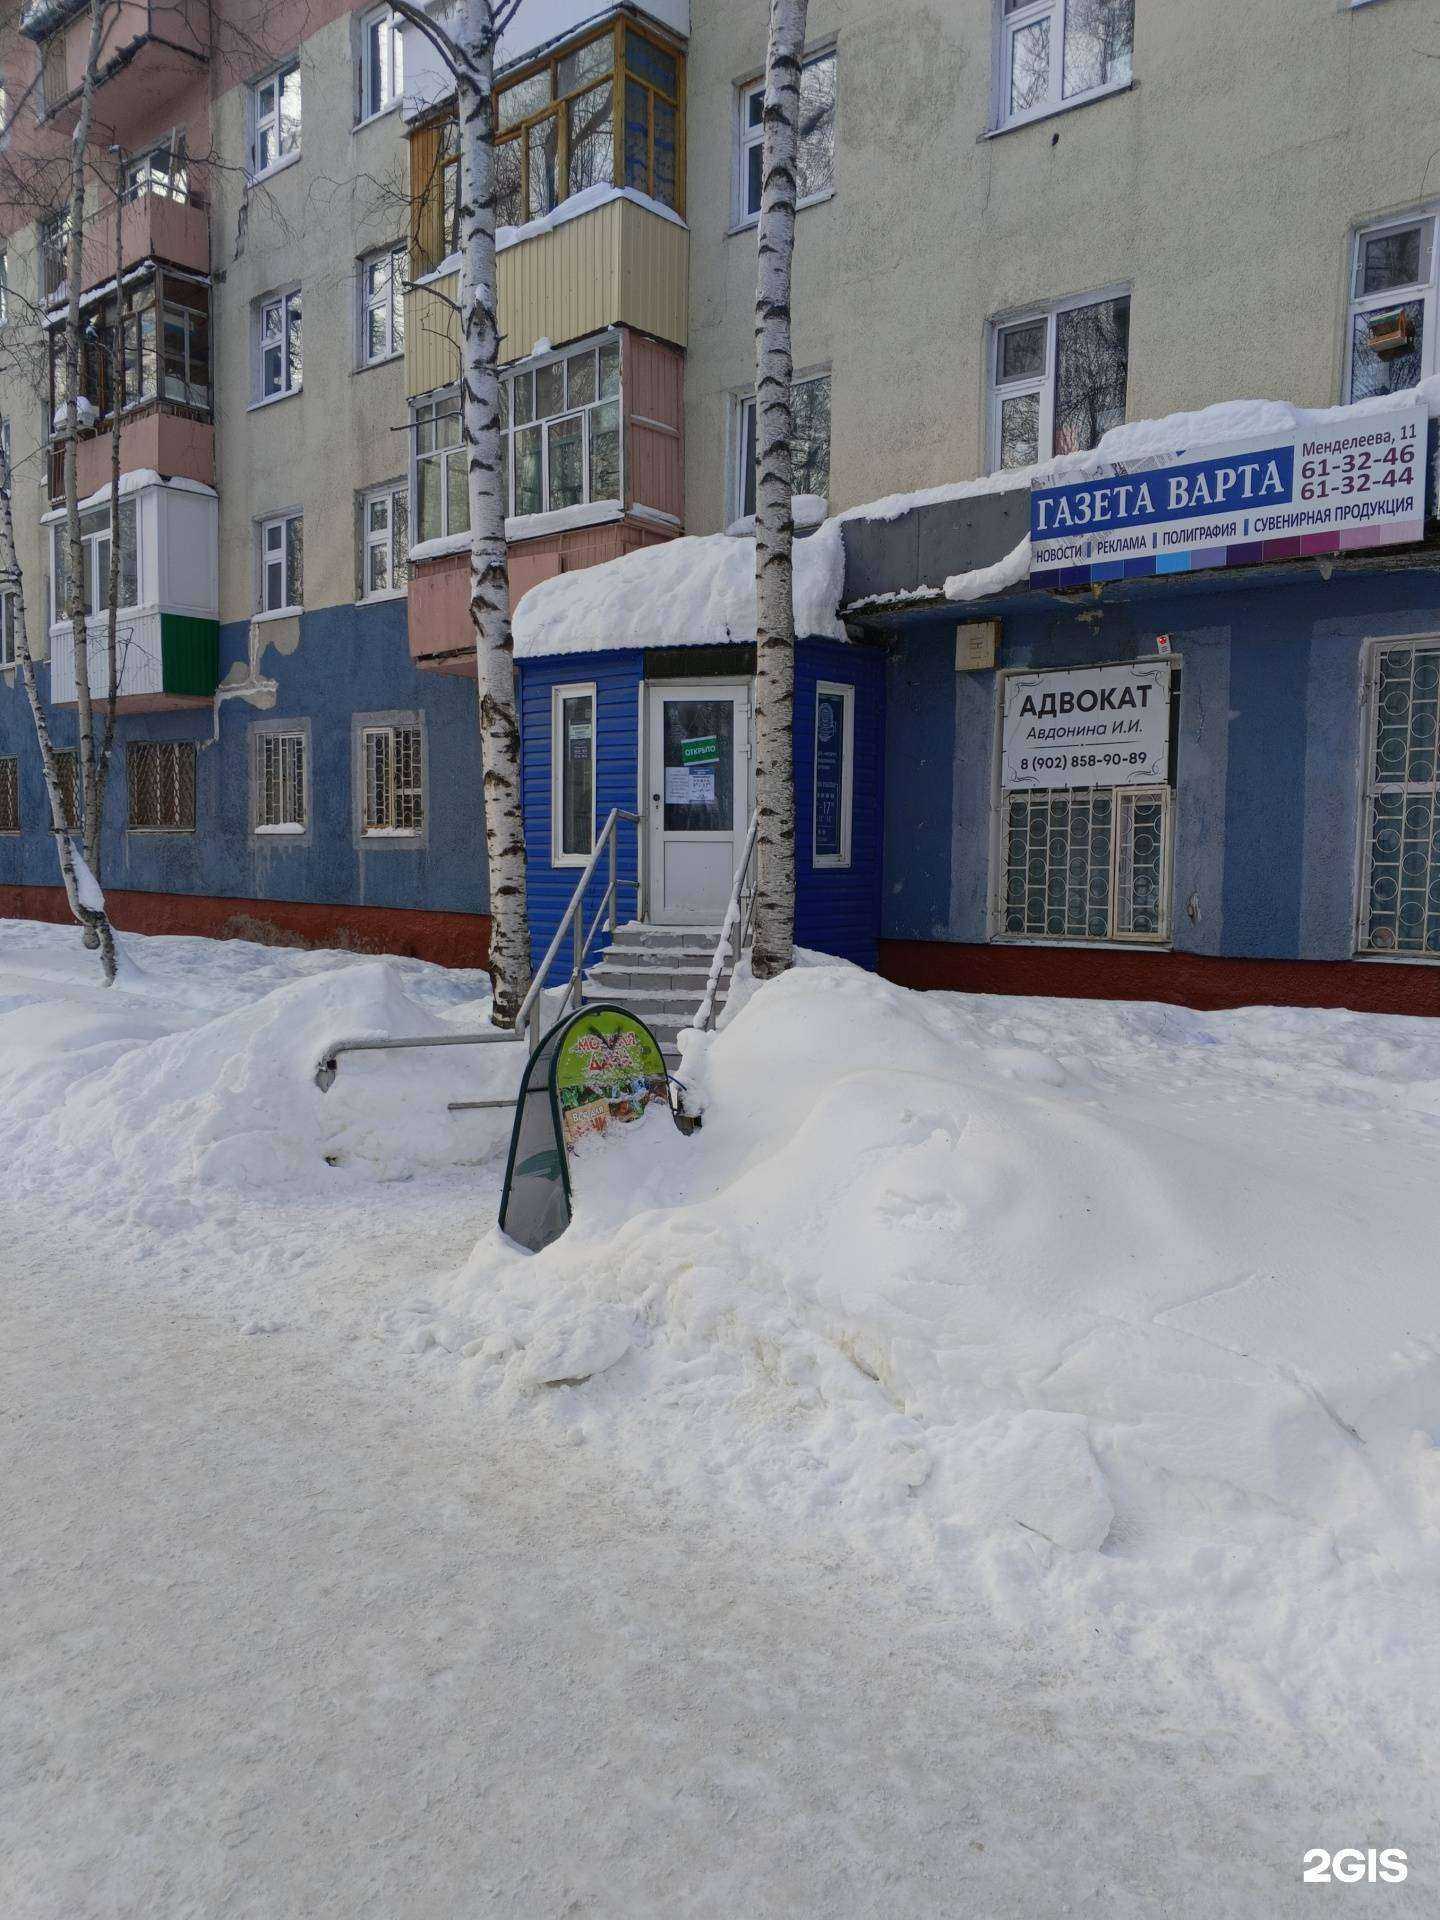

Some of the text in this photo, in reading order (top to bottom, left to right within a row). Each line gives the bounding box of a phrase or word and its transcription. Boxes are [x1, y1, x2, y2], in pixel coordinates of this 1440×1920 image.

[1302, 424, 1417, 457] Менделеева, 11
[1301, 444, 1415, 479] 61-32-46
[1037, 460, 1285, 530] ГАЗЕТА ВАРТА
[1300, 466, 1414, 500] 61-32-44
[1254, 496, 1414, 533] СУВЕНИРНАЯ ПРОДУКЦИЯ
[1097, 535, 1147, 556] РЕКЛАМА
[1163, 521, 1237, 546] ПОЛИГРАФИЯ
[1036, 544, 1083, 564] НОВОСТИ
[1019, 684, 1153, 718] АДВОКАТ
[1026, 719, 1143, 741] Авдонина И.И.
[684, 745, 716, 757] ОТКРЫТО
[1020, 752, 1147, 772] 8 (902) 858-90-89
